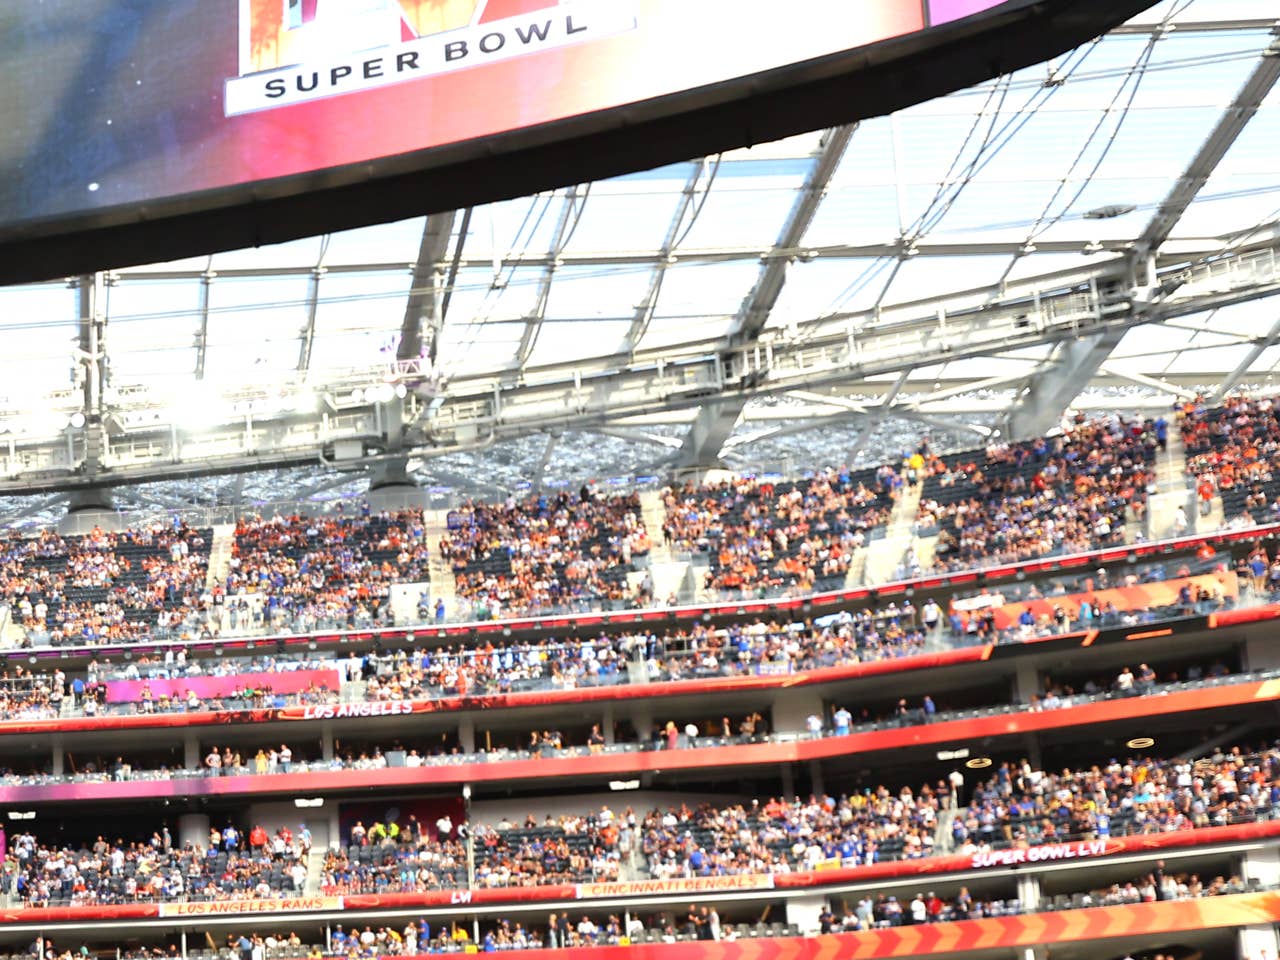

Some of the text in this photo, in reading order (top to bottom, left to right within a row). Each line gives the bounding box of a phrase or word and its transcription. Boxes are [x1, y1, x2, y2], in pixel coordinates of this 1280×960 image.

[264, 15, 588, 99] SUPER BOWL
[303, 700, 413, 720] LOS ANGELES
[972, 840, 1106, 868] SUPER BOWL LVI
[591, 876, 758, 896] CINCINNATI BENGALS
[178, 899, 324, 915] LOS ANGELES RAMS
[451, 892, 472, 904] LVI
